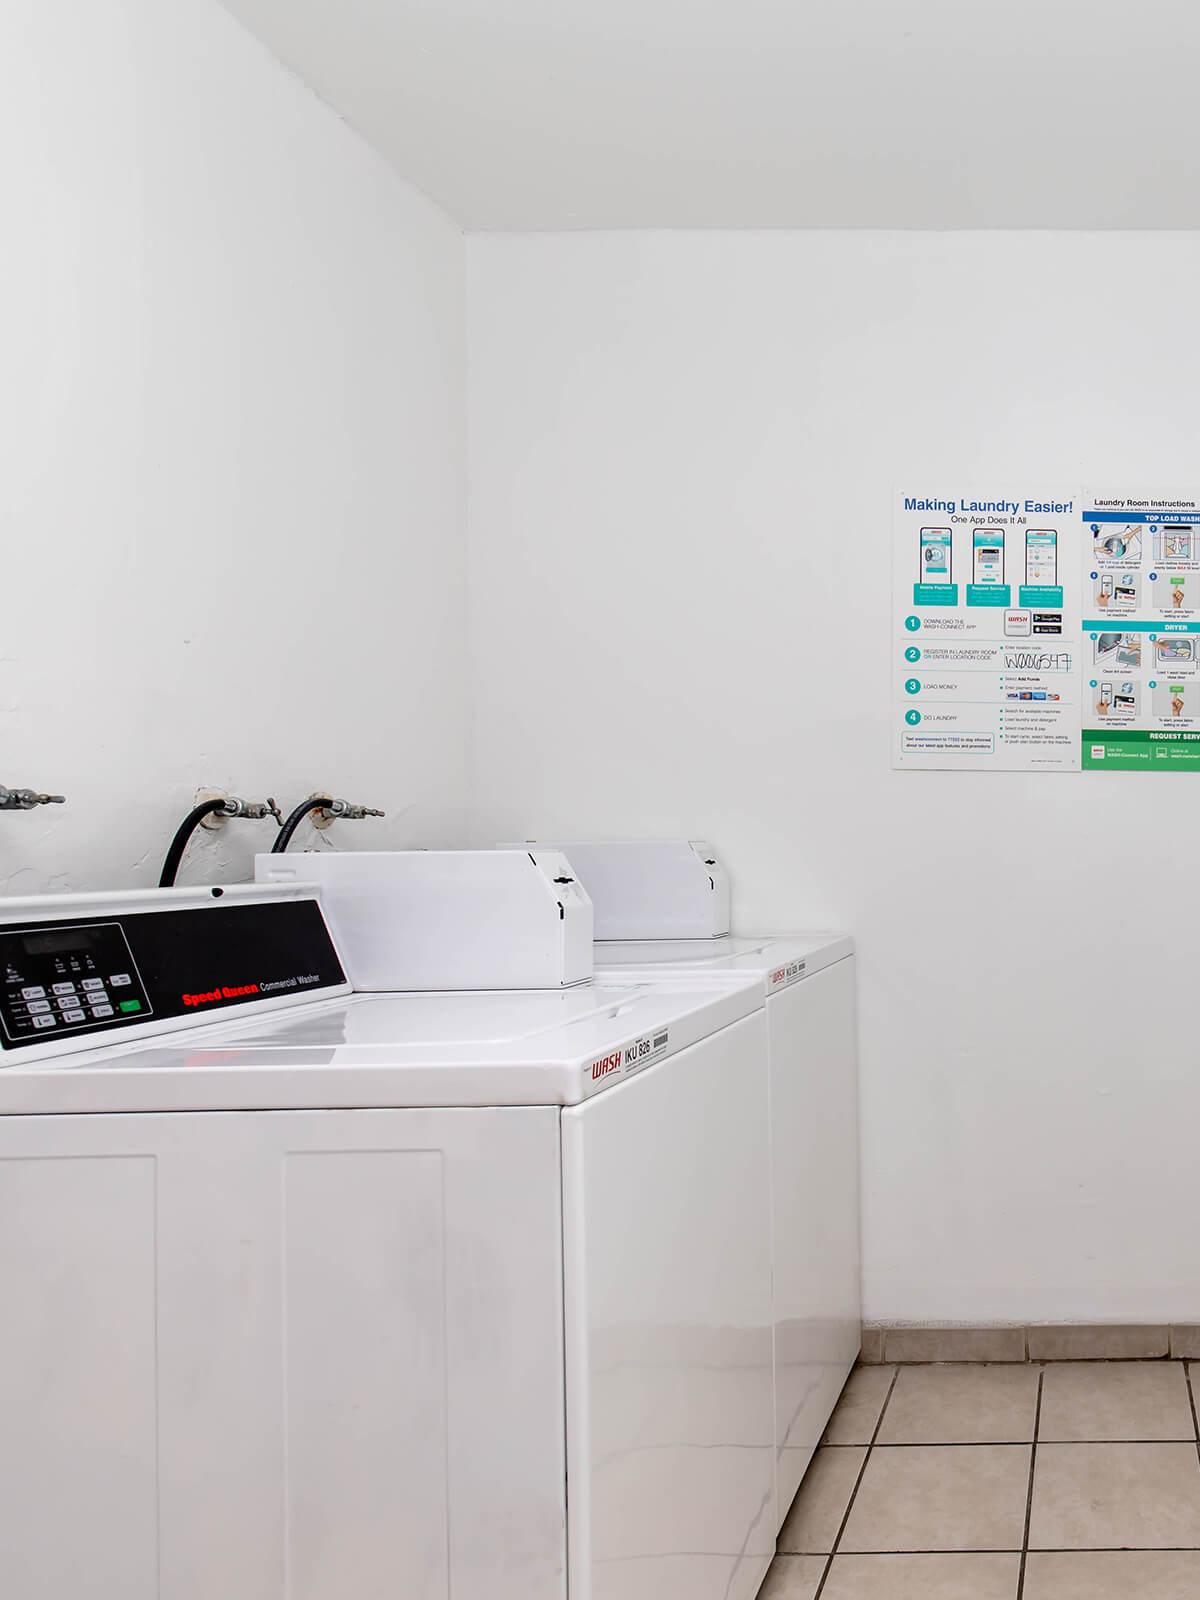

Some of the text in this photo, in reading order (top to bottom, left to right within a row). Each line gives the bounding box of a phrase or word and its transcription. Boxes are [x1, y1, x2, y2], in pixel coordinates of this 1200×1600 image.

[904, 498, 1073, 515] Making Laundry Easier!
[1094, 499, 1125, 507] Laundry
[951, 516, 1026, 525] One App Does It All
[910, 618, 915, 627] 1
[909, 650, 916, 659] 2
[910, 681, 916, 690] 3
[909, 713, 916, 721] 4
[182, 974, 320, 1006] Speed Queen Commercial Washer
[625, 1046, 637, 1064] IKU
[638, 1040, 650, 1056] 826
[592, 1051, 621, 1080] WASH
